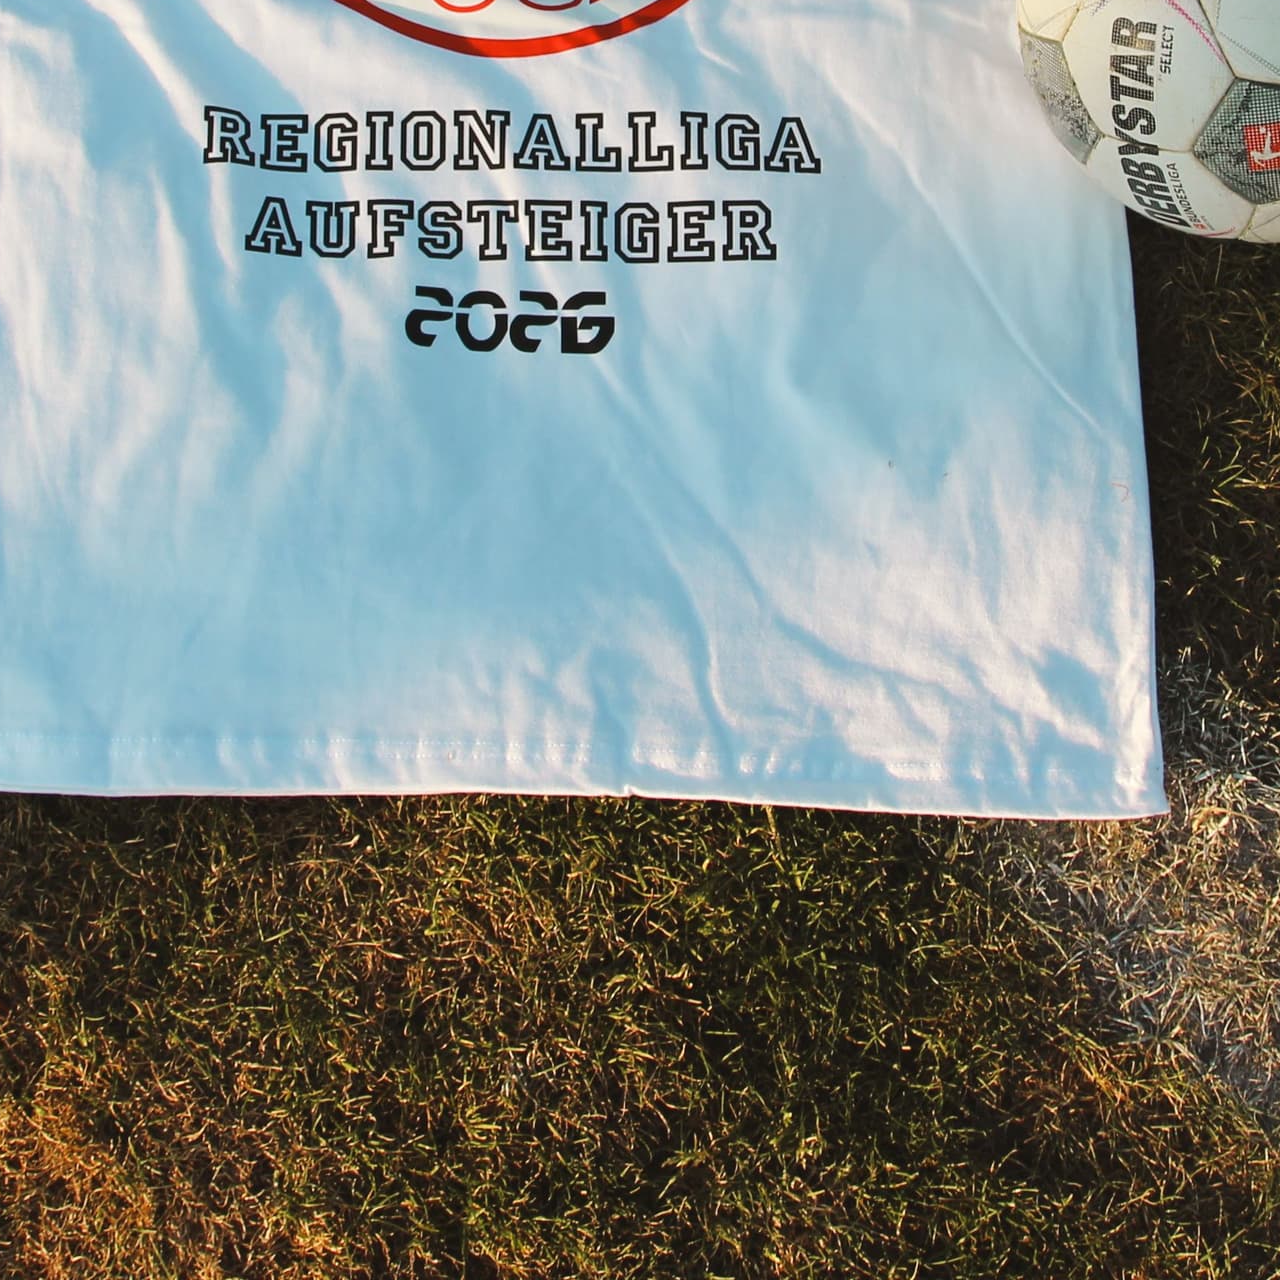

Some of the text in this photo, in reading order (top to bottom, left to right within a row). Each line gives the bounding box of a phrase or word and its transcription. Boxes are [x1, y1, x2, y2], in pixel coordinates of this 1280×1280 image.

[203, 104, 822, 174] REGIONALLIGA
[1109, 17, 1192, 228] DERBYSTAR
[1166, 163, 1198, 222] BUNDESLIGA
[244, 196, 777, 264] AUFSTEIGER
[404, 285, 616, 355] 2026
